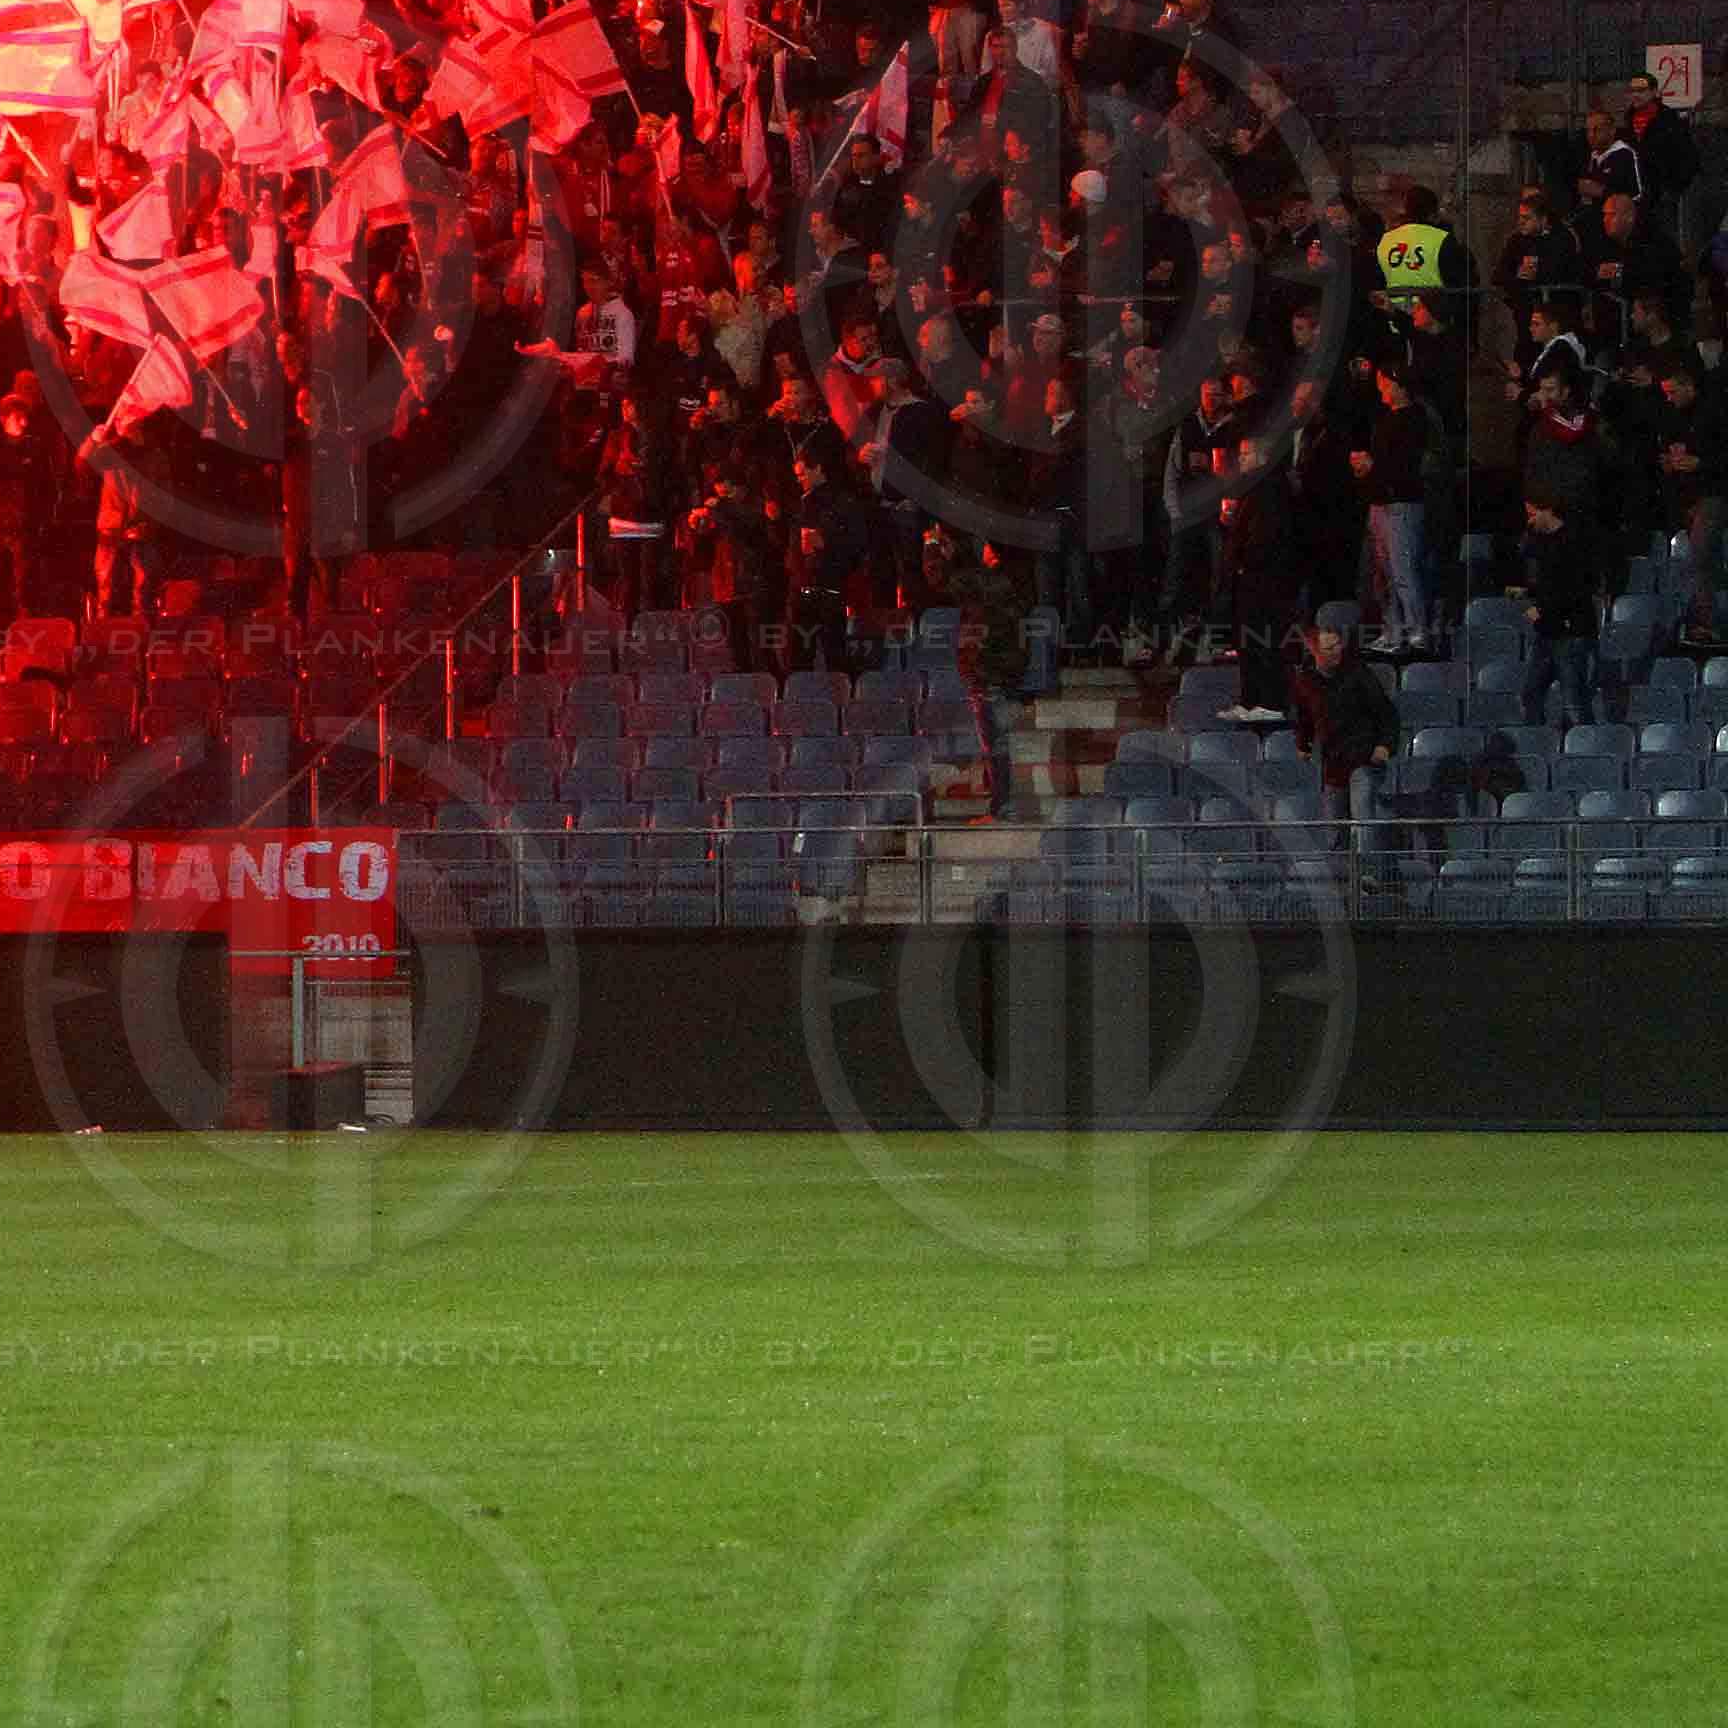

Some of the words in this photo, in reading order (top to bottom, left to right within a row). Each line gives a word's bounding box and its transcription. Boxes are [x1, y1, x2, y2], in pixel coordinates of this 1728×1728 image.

[1658, 55, 1689, 97] 21
[82, 835, 390, 902] BIANCO
[302, 933, 381, 961] 2010
